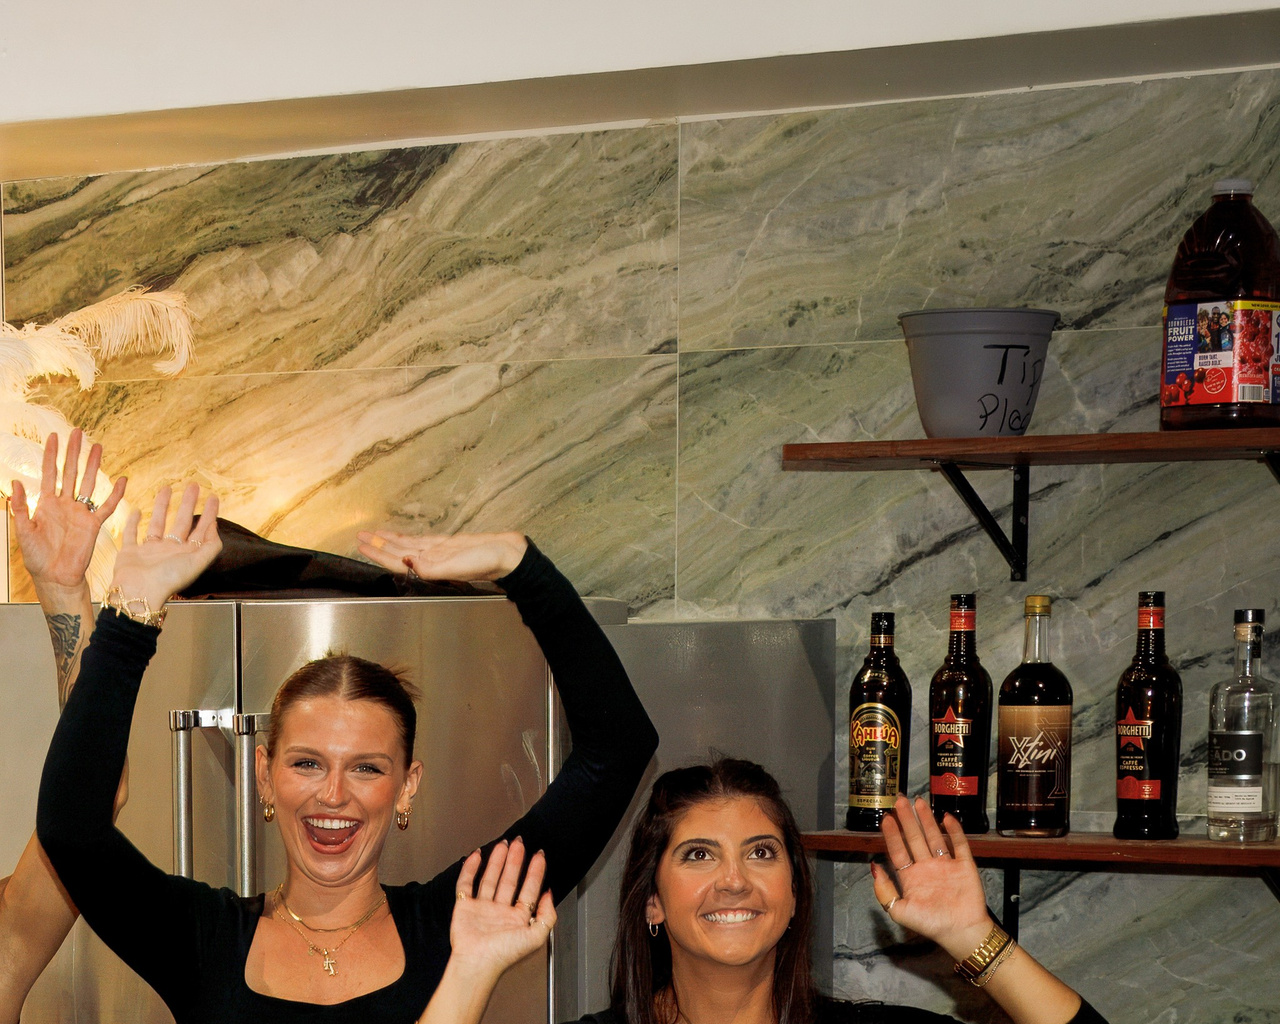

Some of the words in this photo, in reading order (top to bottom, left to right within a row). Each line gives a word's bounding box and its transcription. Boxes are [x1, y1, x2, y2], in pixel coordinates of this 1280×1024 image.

[1168, 326, 1195, 336] FRUIT
[934, 723, 969, 734] BORGHETTI
[1118, 725, 1149, 735] BORGHETTI
[851, 721, 899, 748] KAHLÚA
[1008, 731, 1062, 768] Xtini
